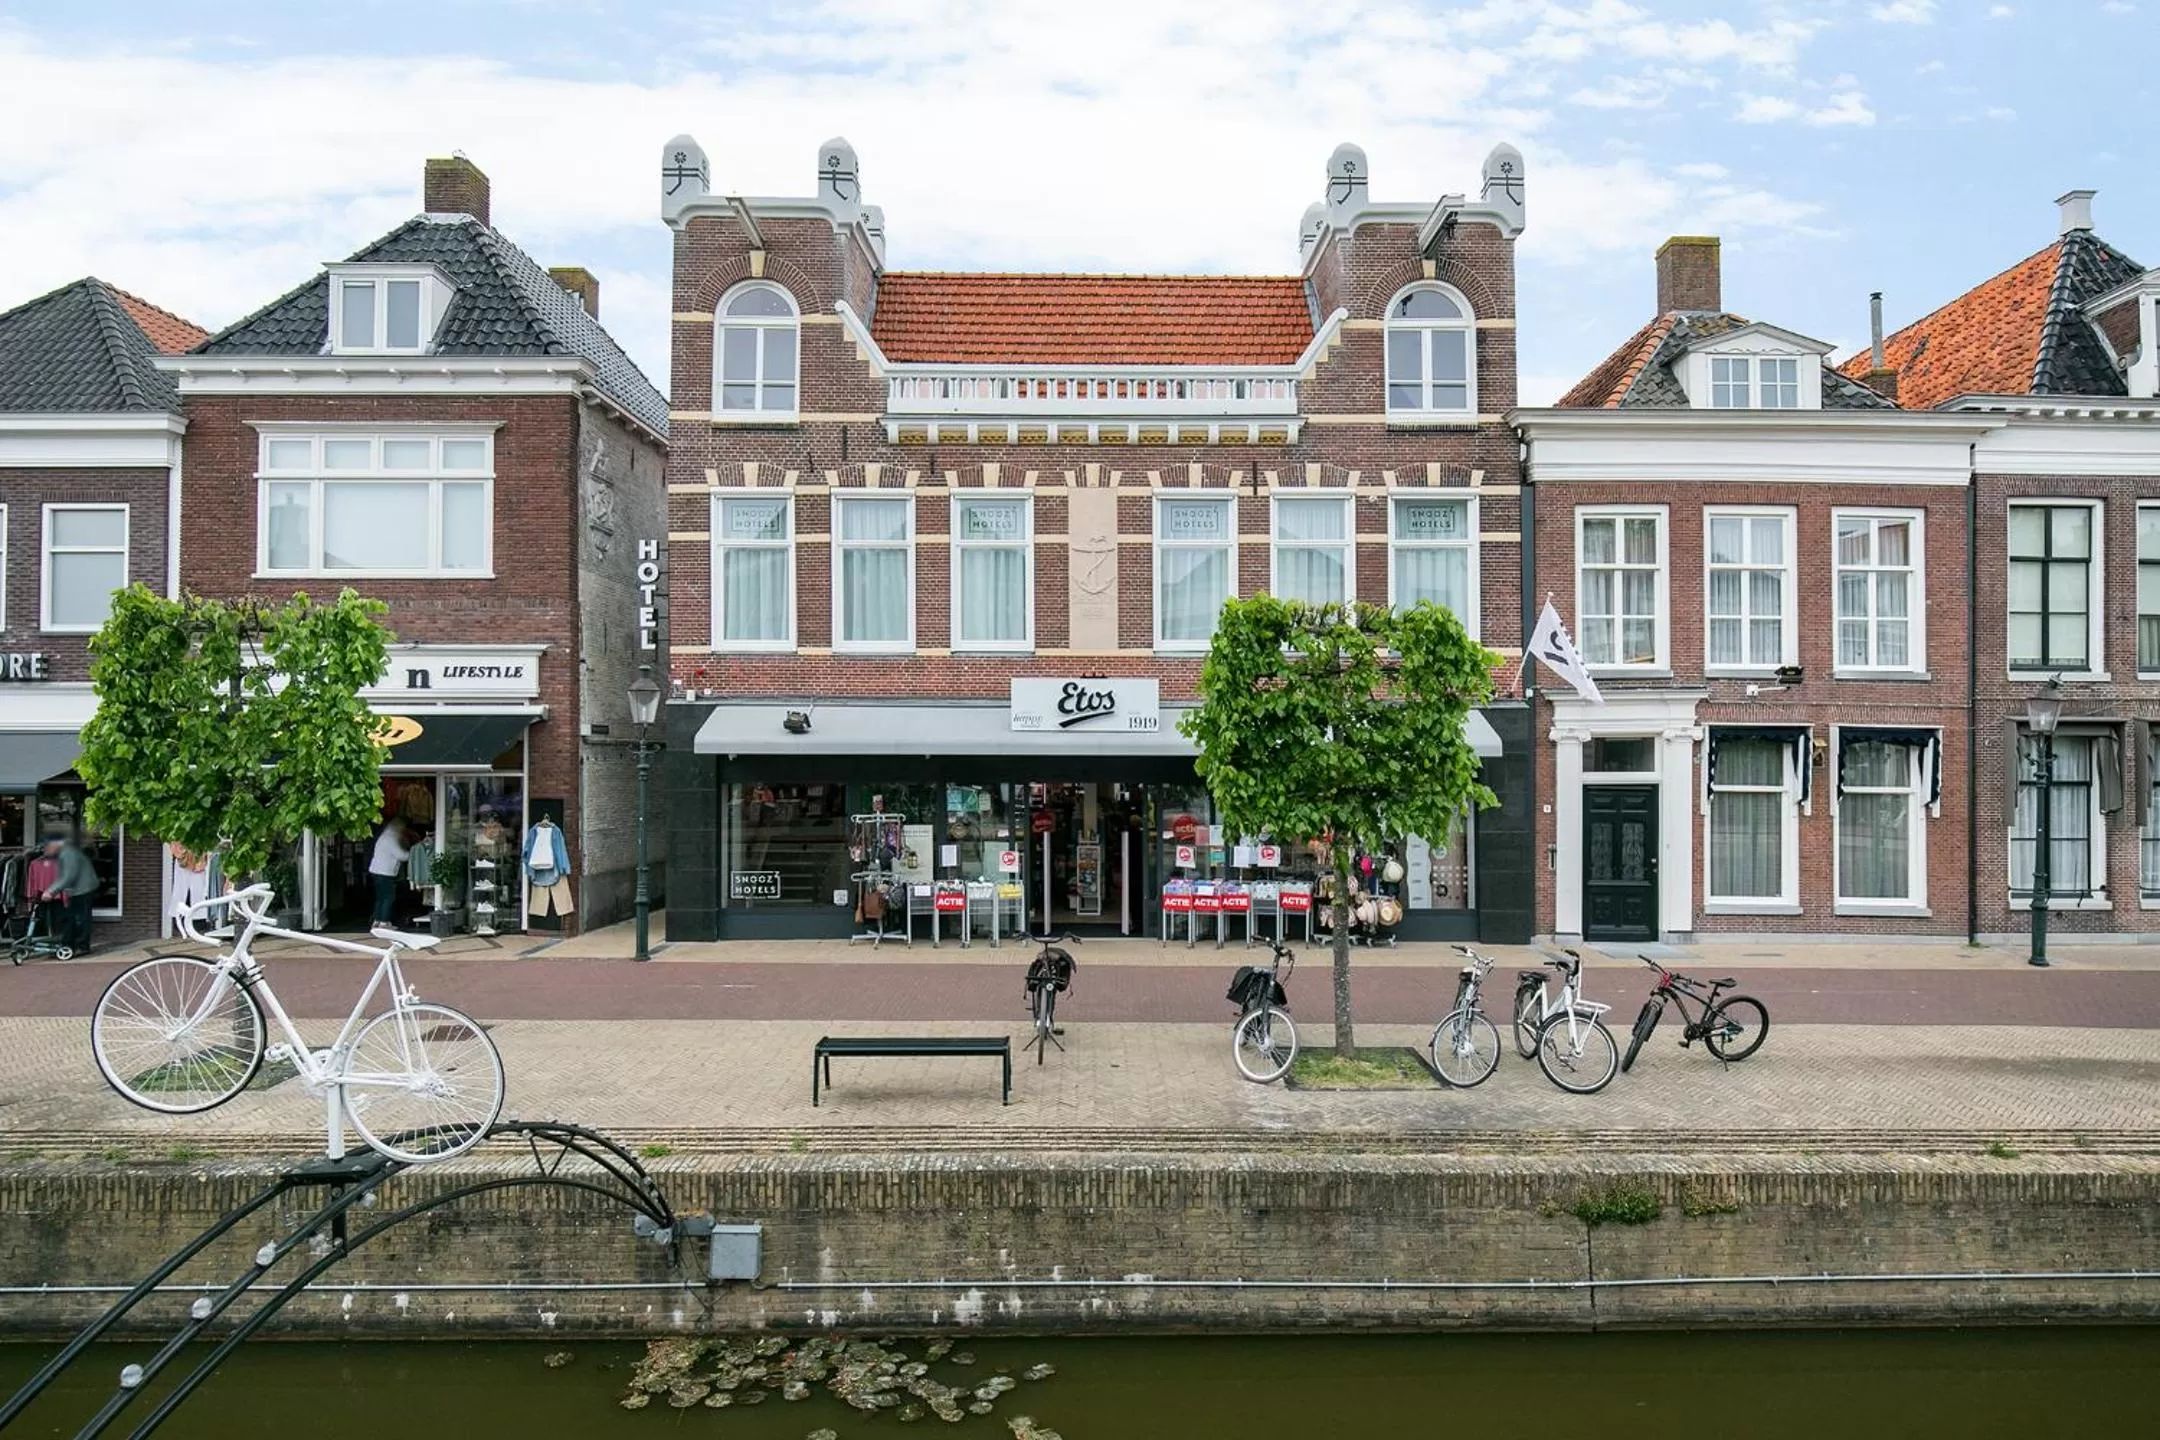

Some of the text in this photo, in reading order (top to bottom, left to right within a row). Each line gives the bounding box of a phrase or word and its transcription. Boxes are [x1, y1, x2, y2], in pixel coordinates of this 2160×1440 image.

[638, 539, 659, 650] HOTEL
[0, 653, 42, 678] RE
[443, 666, 524, 678] LIFESTYLE
[1057, 681, 1116, 715] Etos
[1128, 716, 1158, 729] 1919
[735, 886, 776, 894] HOTELS
[937, 897, 965, 906] ACTIE
[1164, 898, 1191, 907] ACTIE
[1194, 898, 1219, 907] ACTIE
[1222, 898, 1248, 907] ACTIE
[1282, 896, 1309, 905] ACTIE
